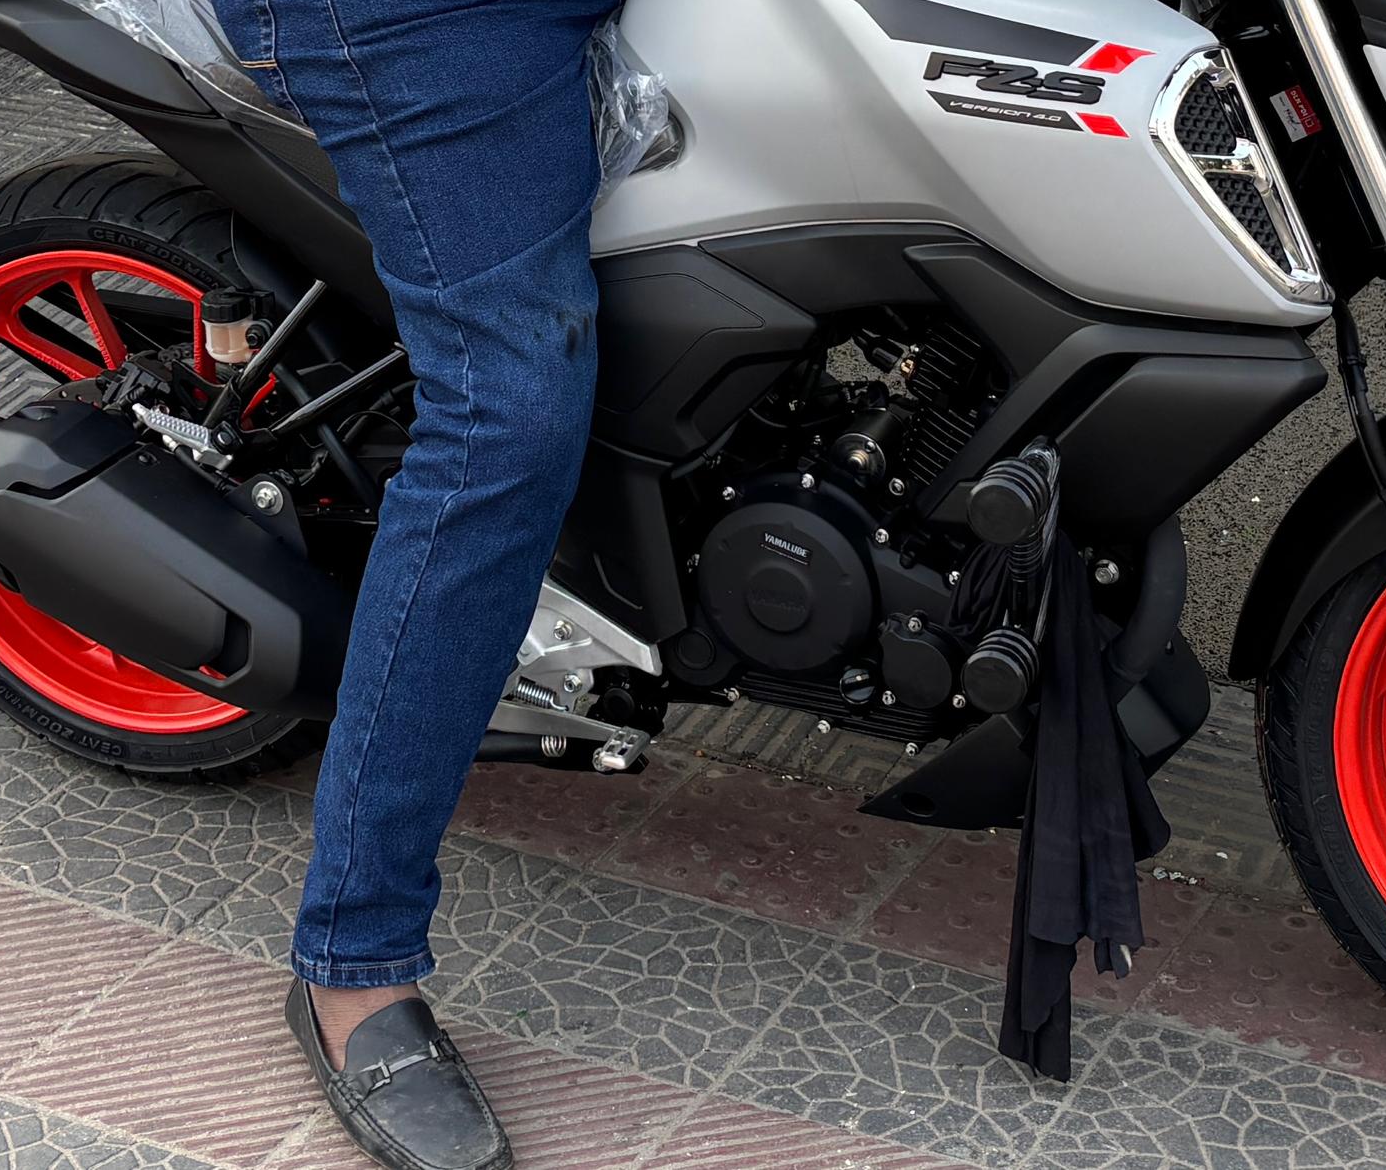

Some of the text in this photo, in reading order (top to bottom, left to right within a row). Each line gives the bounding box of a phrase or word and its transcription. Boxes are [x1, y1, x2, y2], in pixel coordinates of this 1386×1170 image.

[949, 99, 1062, 123] VERSION 4.0
[93, 227, 201, 277] CEAT ZOOM
[764, 532, 808, 558] YAMALUBE
[21, 703, 74, 739] ZOOM
[78, 734, 123, 756] CEAT
